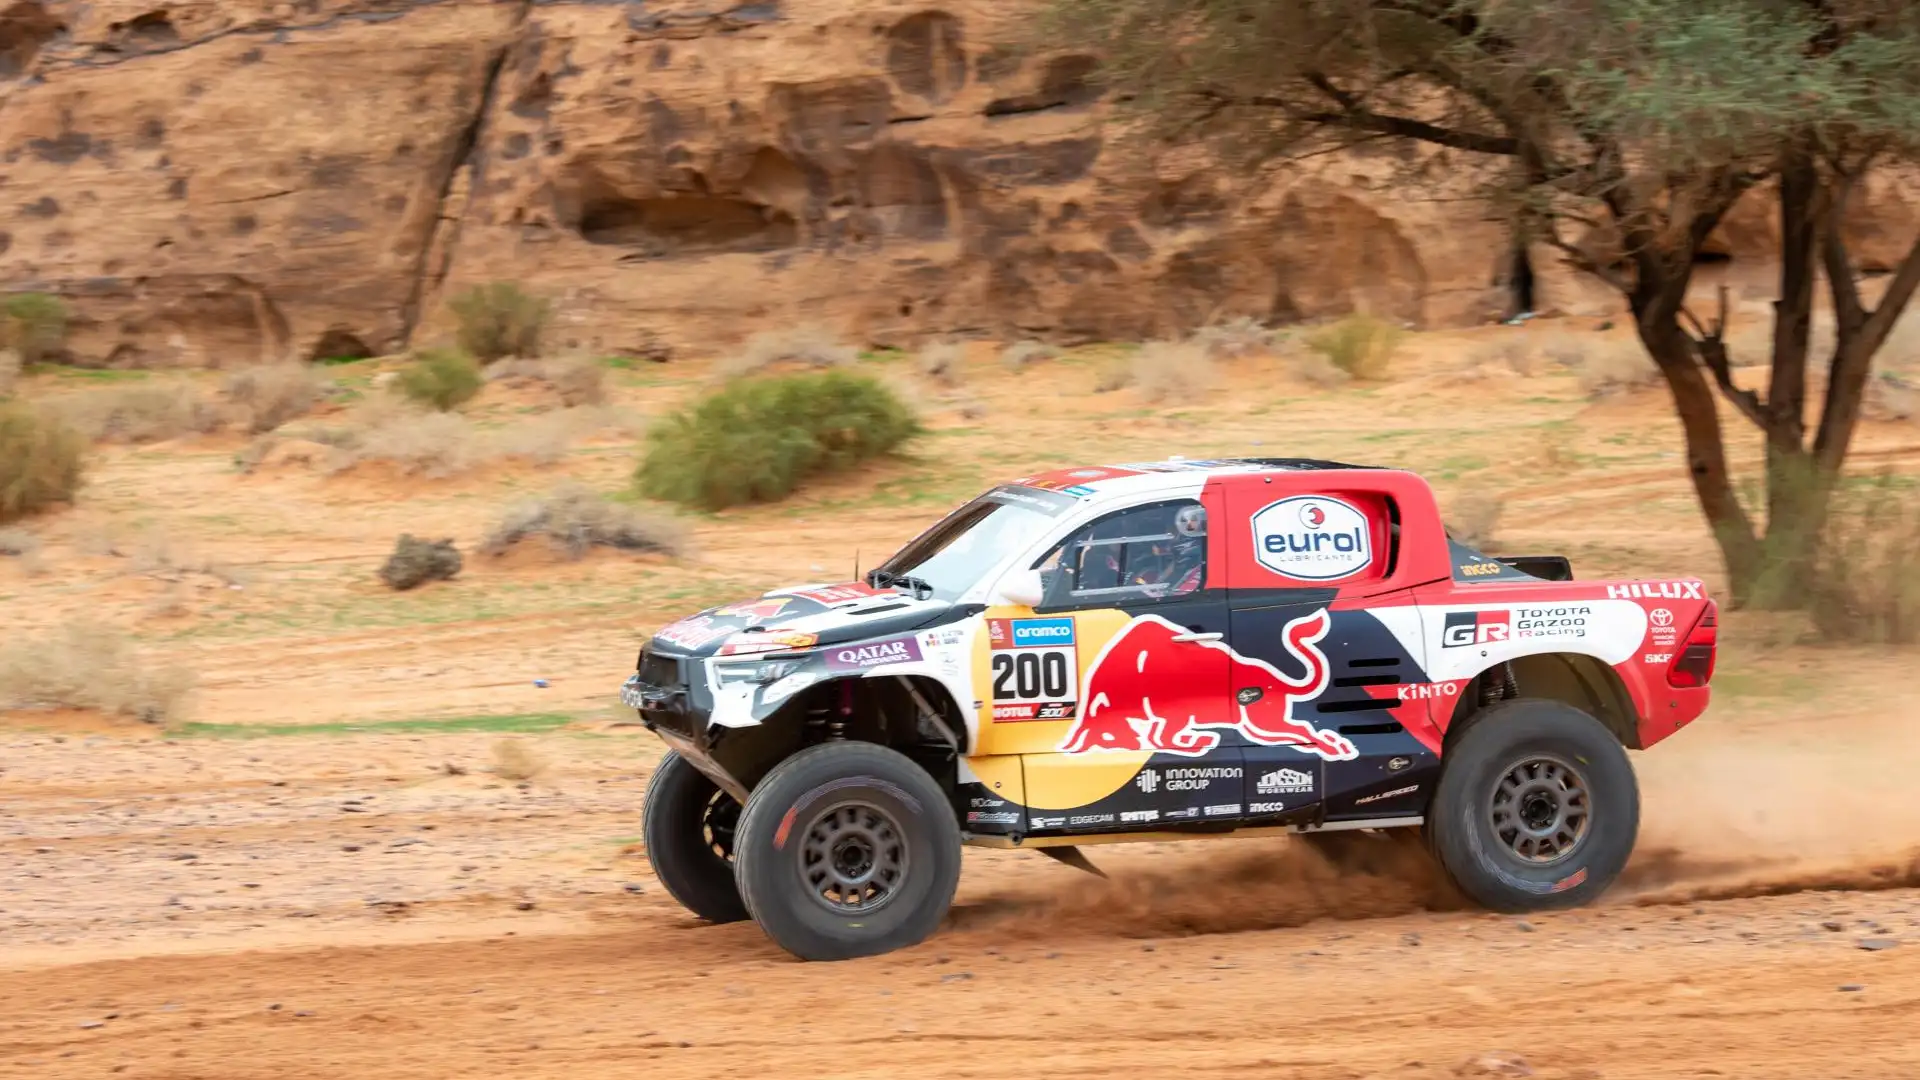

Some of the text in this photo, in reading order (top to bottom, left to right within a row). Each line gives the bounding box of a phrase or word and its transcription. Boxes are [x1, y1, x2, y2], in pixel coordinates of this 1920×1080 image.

[1264, 527, 1362, 553] eurol
[1606, 581, 1703, 600] HILUX
[1517, 607, 1591, 618] TOYOTA
[1517, 618, 1586, 629] GAZOO
[1016, 626, 1071, 637] aramco
[1444, 623, 1509, 646] GR
[1518, 628, 1586, 637] Racing
[1650, 626, 1677, 634] TOYOTA
[837, 641, 909, 664] QATAR
[1644, 653, 1673, 663] SKF
[991, 651, 1068, 700] 200
[1165, 779, 1210, 791] GROUP
[1257, 786, 1314, 795] WORKWEAR
[1069, 813, 1115, 825] EDGECAM
